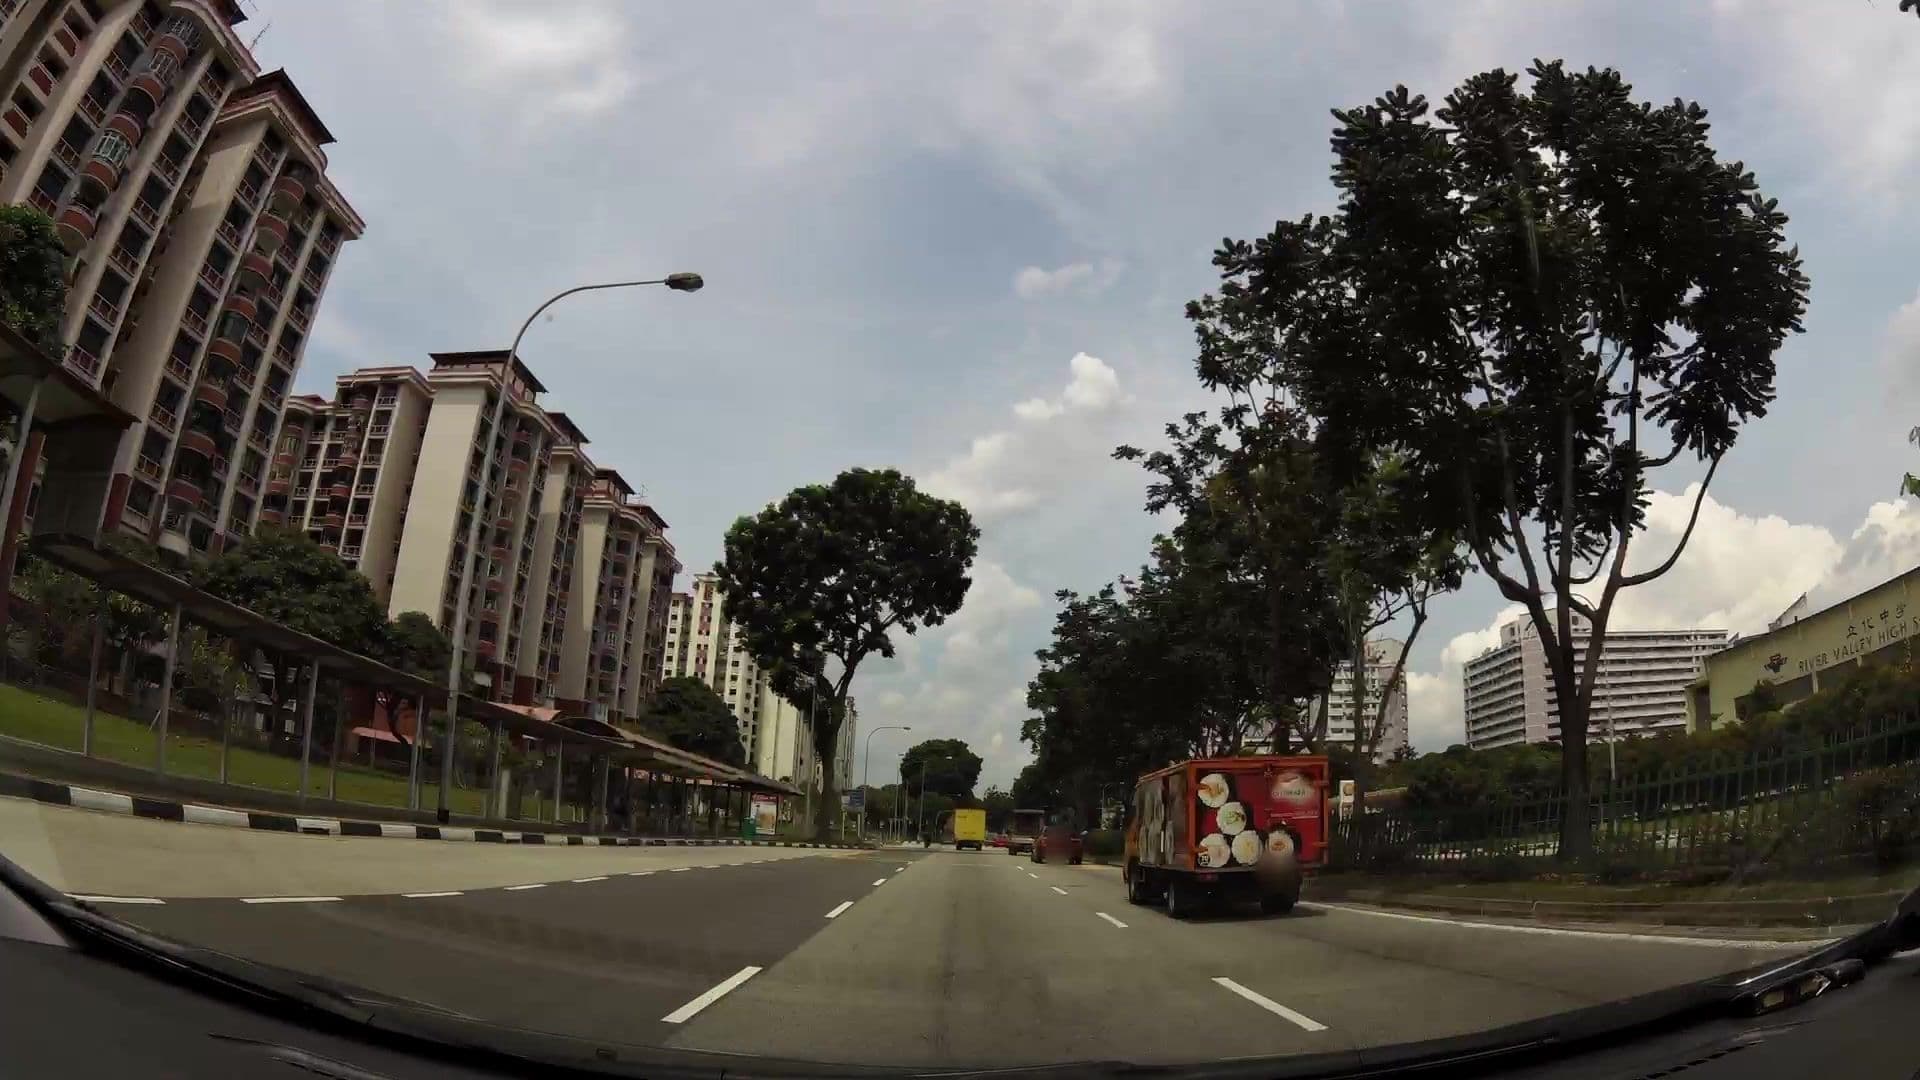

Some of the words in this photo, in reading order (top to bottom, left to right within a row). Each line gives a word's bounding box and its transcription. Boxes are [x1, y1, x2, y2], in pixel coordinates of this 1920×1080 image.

[1799, 652, 1829, 673] RIVER
[1832, 635, 1872, 660] VALLEY
[1878, 620, 1907, 644] HIGH
